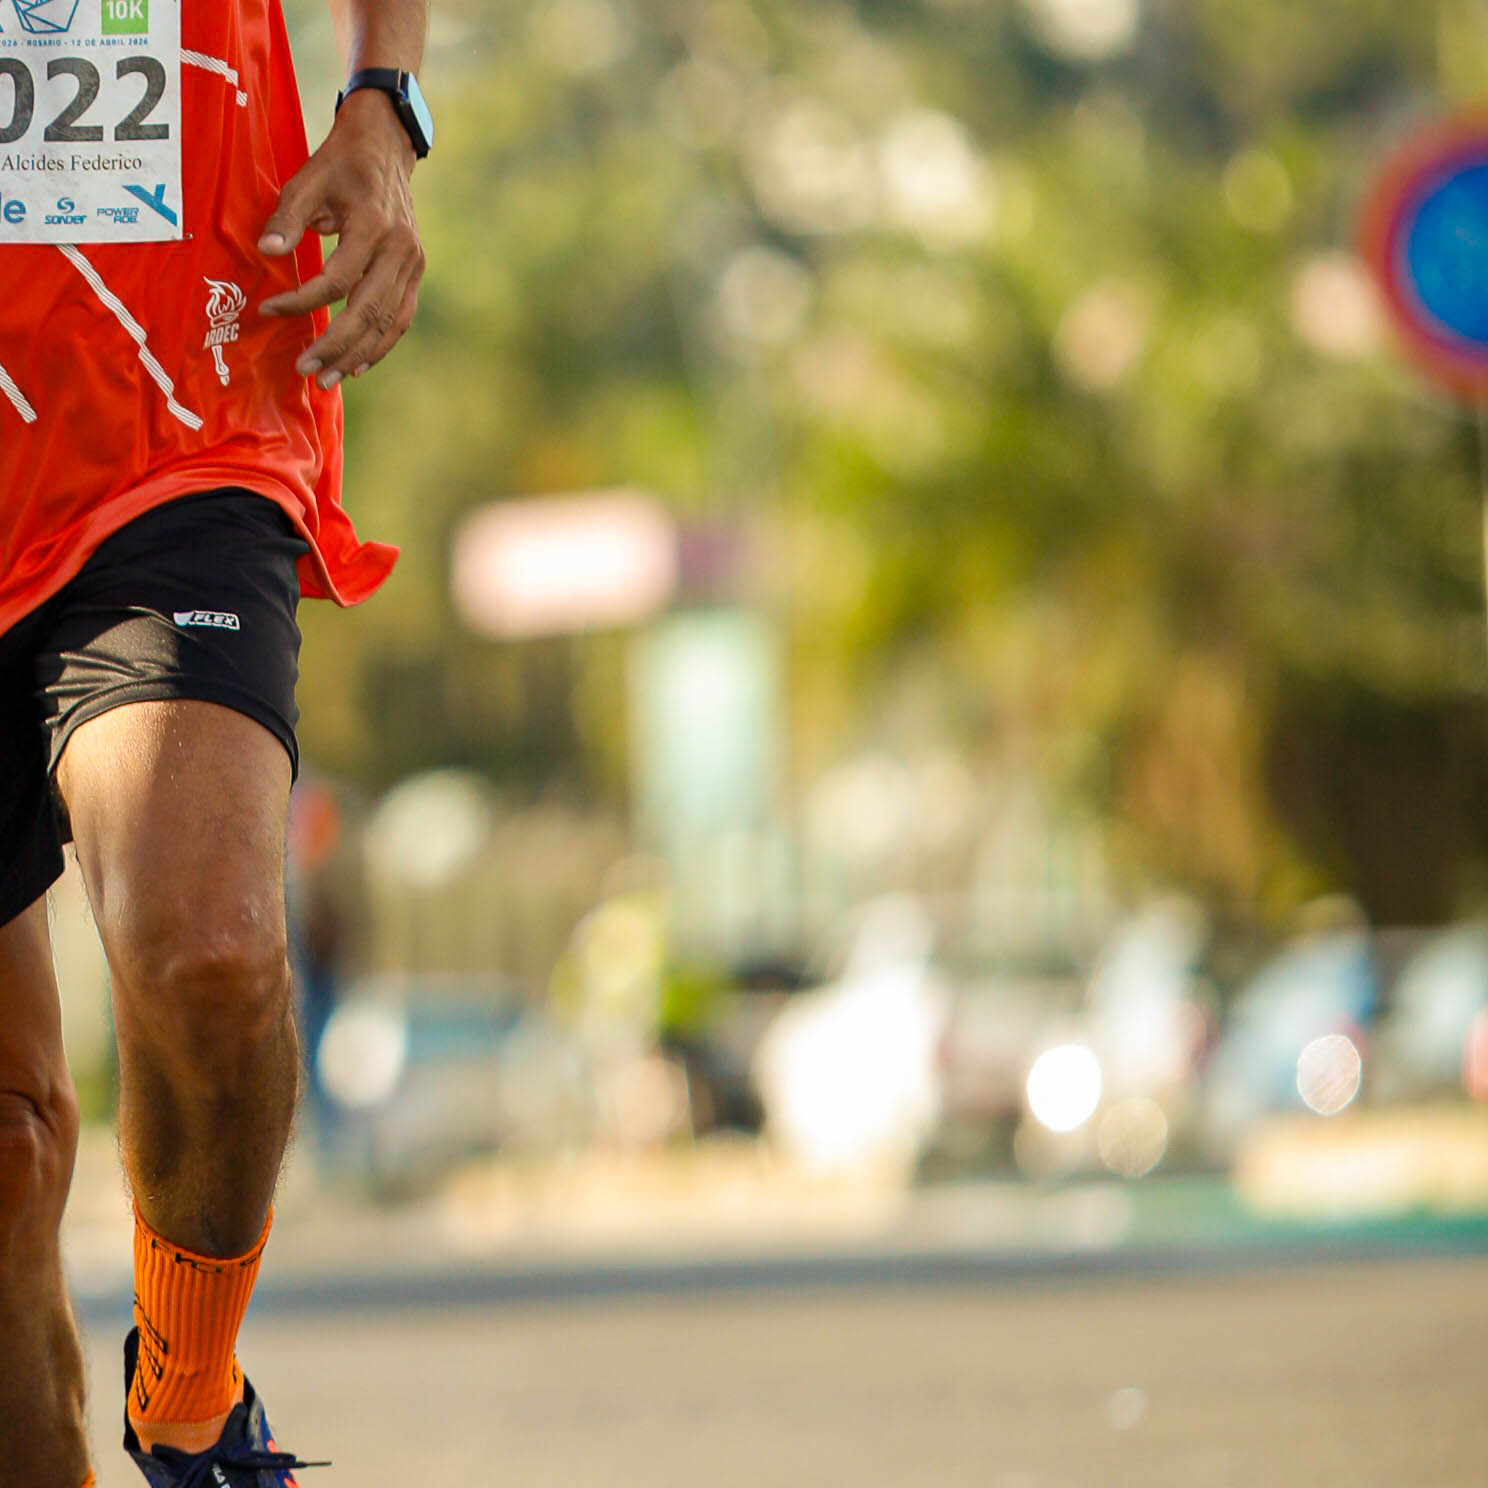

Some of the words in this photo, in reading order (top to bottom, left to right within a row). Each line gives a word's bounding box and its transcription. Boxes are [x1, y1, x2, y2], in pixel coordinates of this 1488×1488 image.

[107, 0, 144, 20] 10K
[26, 39, 61, 47] ROSARIO
[85, 39, 97, 47] DE
[100, 38, 125, 46] ABRIL
[1, 154, 65, 172] Alcides
[70, 153, 143, 171] Federico
